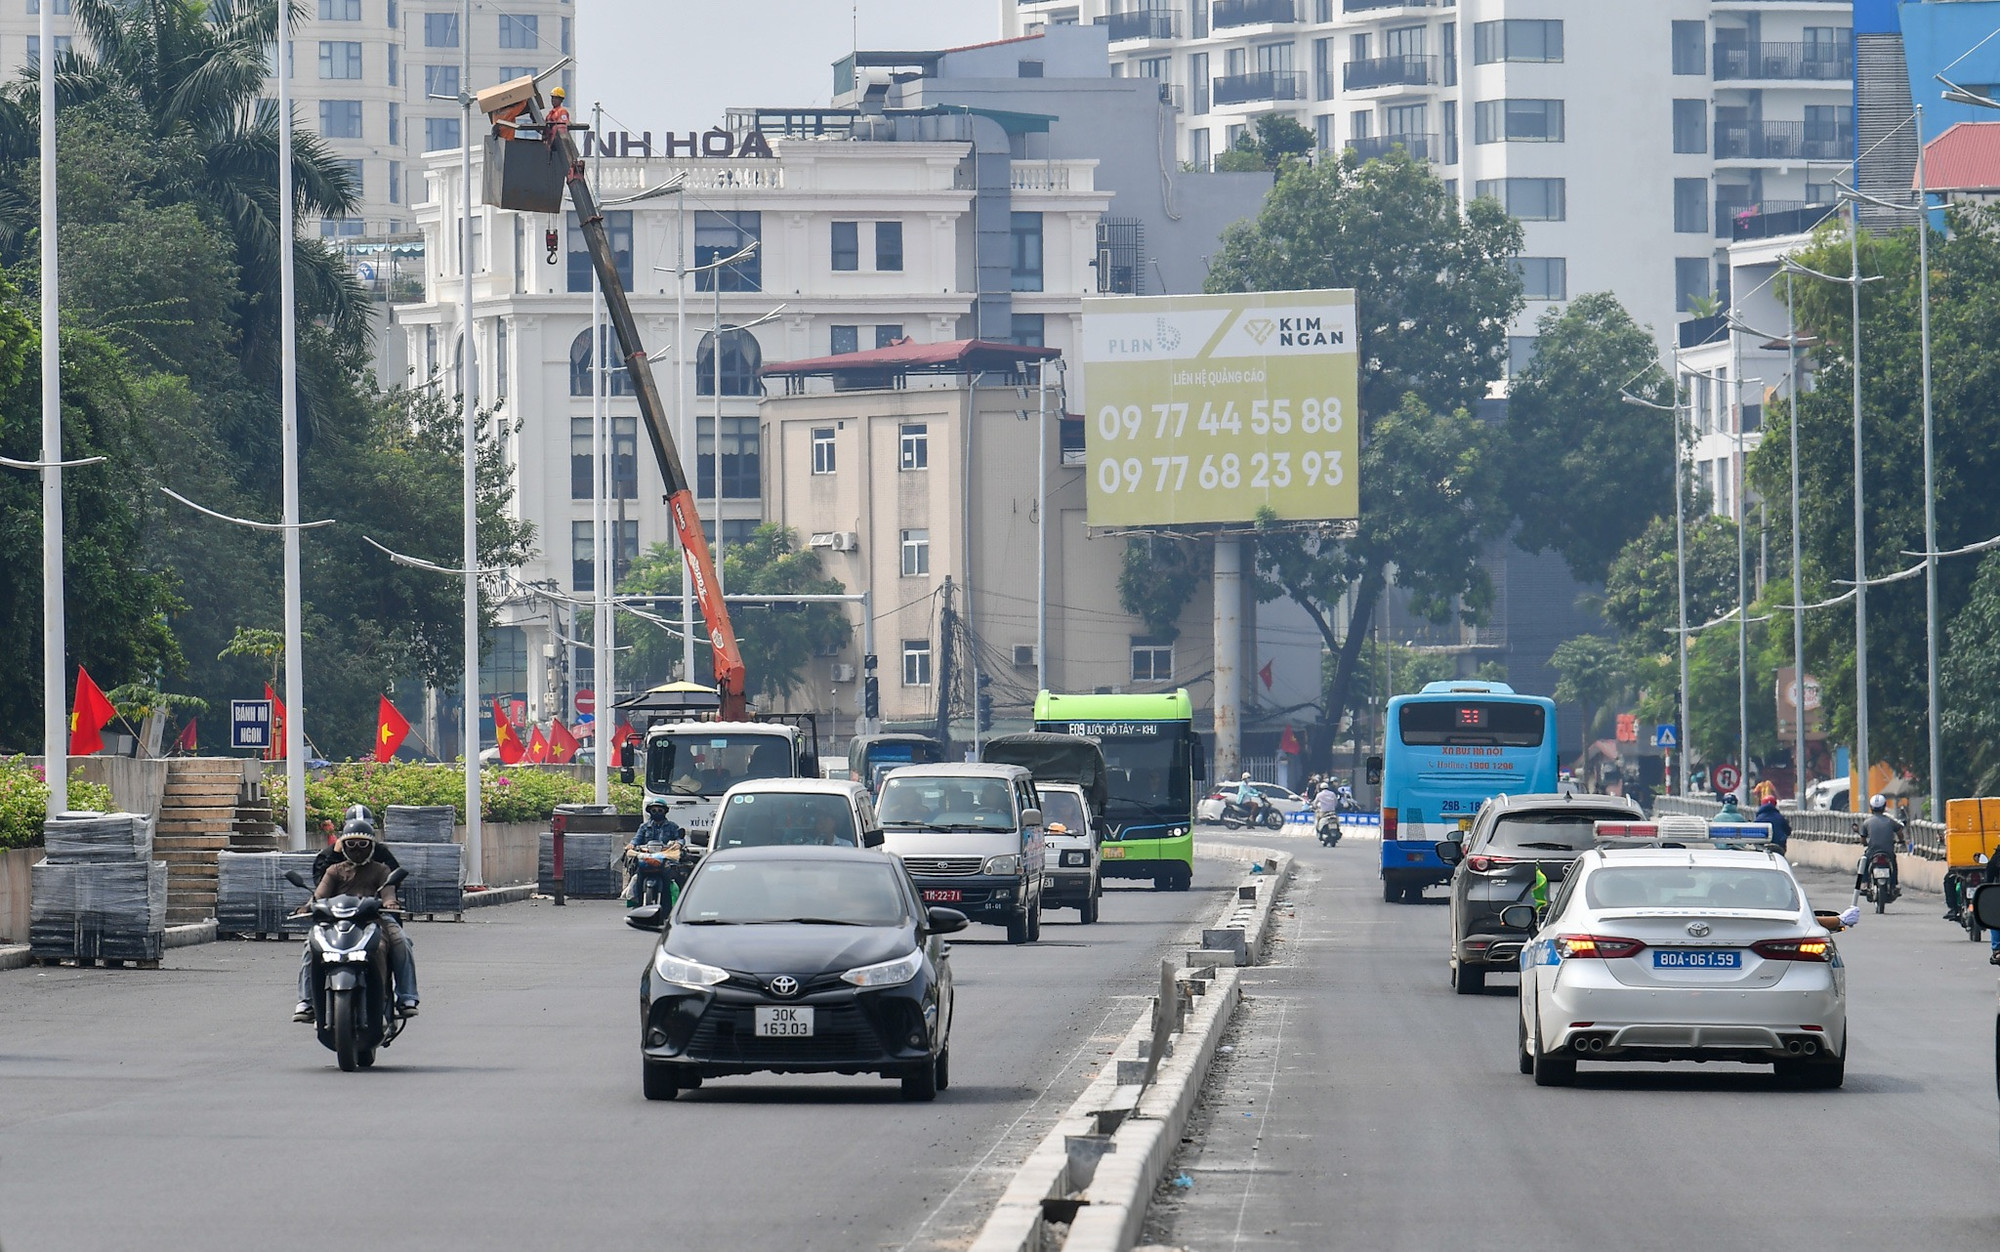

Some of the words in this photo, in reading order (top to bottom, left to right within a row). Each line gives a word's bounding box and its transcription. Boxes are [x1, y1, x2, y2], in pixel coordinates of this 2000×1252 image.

[666, 125, 773, 158] HÒA
[1279, 317, 1321, 332] KIM
[1109, 338, 1153, 354] PLAN
[1280, 331, 1344, 347] NGAN
[1173, 371, 1193, 386] LIÊN
[1195, 371, 1206, 388] HỆ
[1208, 367, 1243, 385] QUẢNG
[1244, 368, 1265, 383] CÁO
[1098, 404, 1143, 441] 09
[1151, 403, 1190, 439] 77
[1198, 401, 1242, 436] 44
[1251, 399, 1293, 435] 55
[1301, 397, 1344, 434] 88
[1098, 457, 1143, 494] 09
[1151, 455, 1190, 492] 77
[1199, 453, 1242, 490] 68
[1250, 452, 1292, 488] 23
[1302, 450, 1344, 487] 93
[235, 703, 256, 722] BÁNH
[257, 703, 268, 722] MÌ
[240, 727, 262, 743] NGON
[1069, 723, 1086, 736] E09
[1106, 722, 1118, 735] HỒ
[1118, 723, 1135, 735] TÂY
[1142, 725, 1157, 735] KHU
[1455, 747, 1471, 756] BUS
[1442, 800, 1460, 811] 29B
[690, 816, 700, 826] XỬ
[701, 817, 709, 826] LÝ
[1660, 953, 1734, 967] 80A-061.59
[772, 1008, 797, 1021] 30K
[763, 1022, 808, 1035] 163.03
